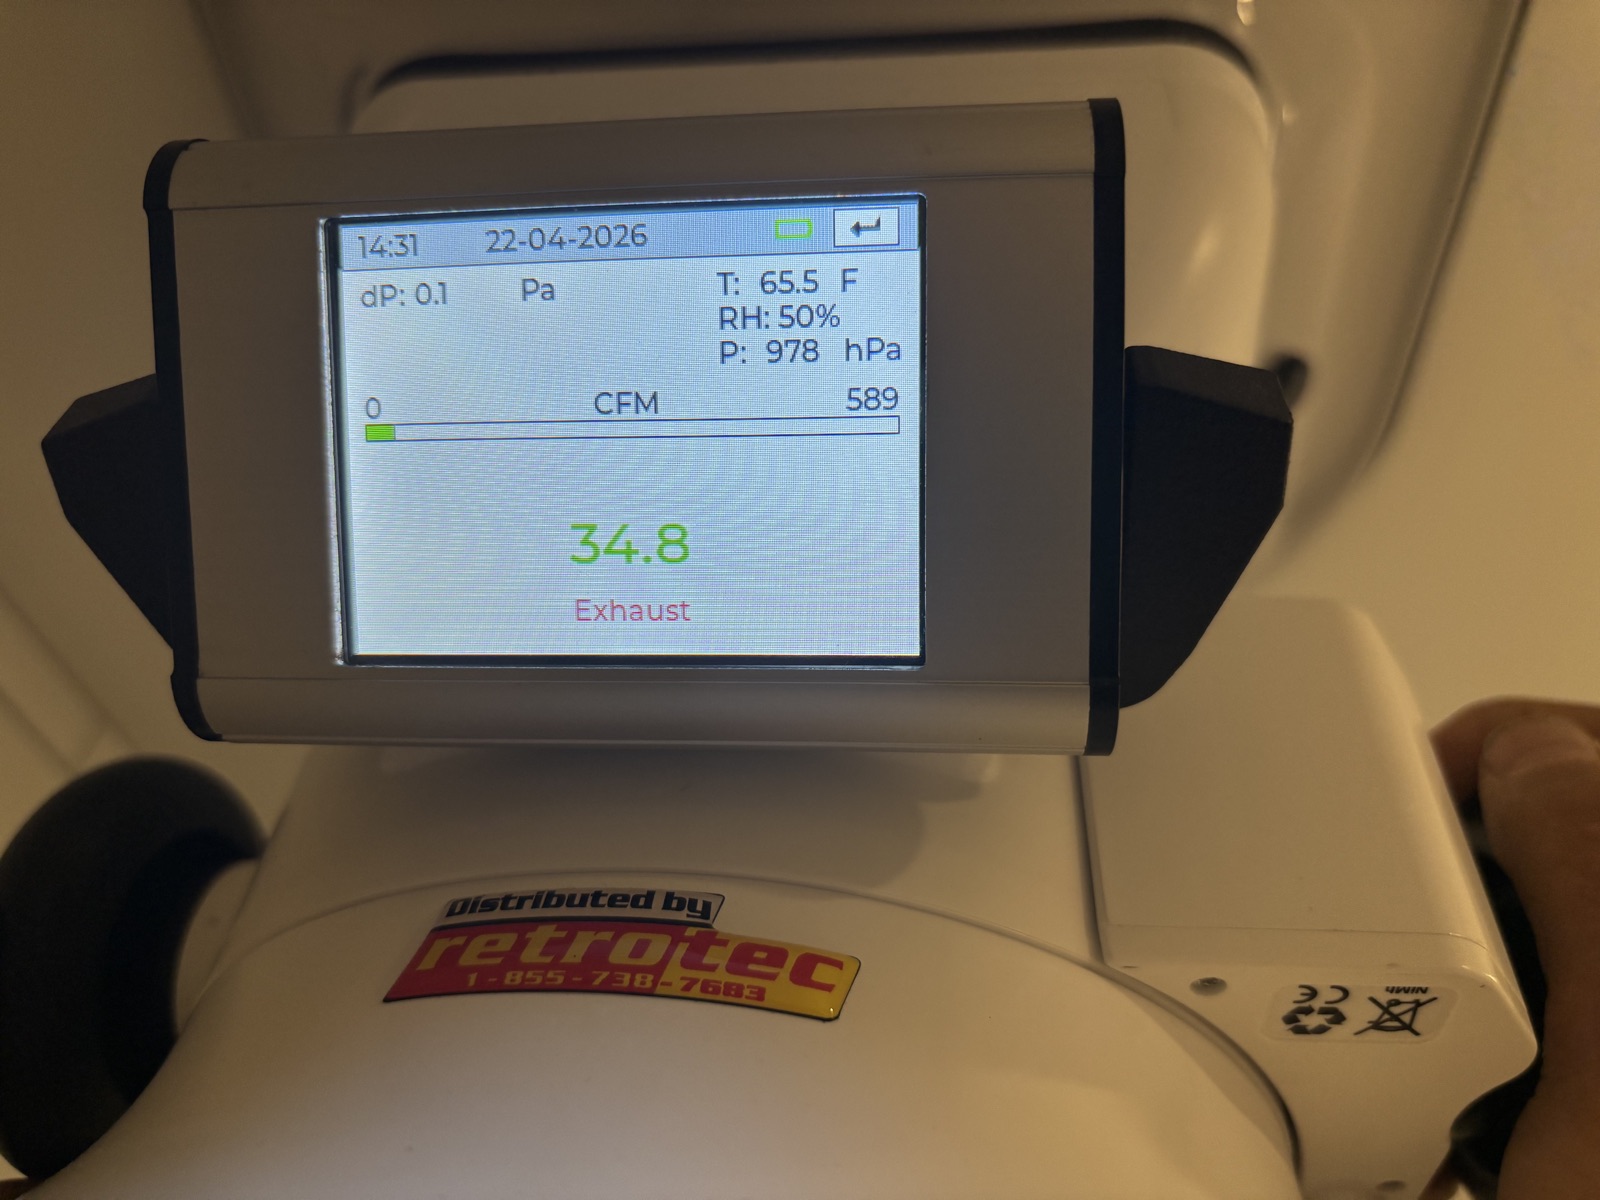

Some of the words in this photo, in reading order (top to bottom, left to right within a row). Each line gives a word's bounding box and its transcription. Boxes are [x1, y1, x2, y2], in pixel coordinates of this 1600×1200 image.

[357, 234, 419, 259] 14:31
[486, 224, 648, 253] 22-04-2026
[360, 284, 406, 308] dP:
[415, 282, 449, 305] 0.1
[521, 278, 556, 301] Pa
[716, 272, 740, 295] T:
[760, 270, 819, 294] 65.5
[842, 268, 858, 291] F
[719, 306, 770, 330] RH:
[778, 304, 841, 328] 50%
[721, 341, 747, 363] P:
[766, 339, 819, 363] 978
[845, 337, 901, 362] hPa
[365, 397, 382, 419] 0
[594, 391, 660, 414] CFM
[847, 386, 900, 410] 589
[569, 523, 691, 564] 34.8
[575, 599, 692, 621] Exhaust
[445, 890, 655, 918] Distributed
[661, 892, 713, 920] by
[415, 924, 844, 993] retrotec
